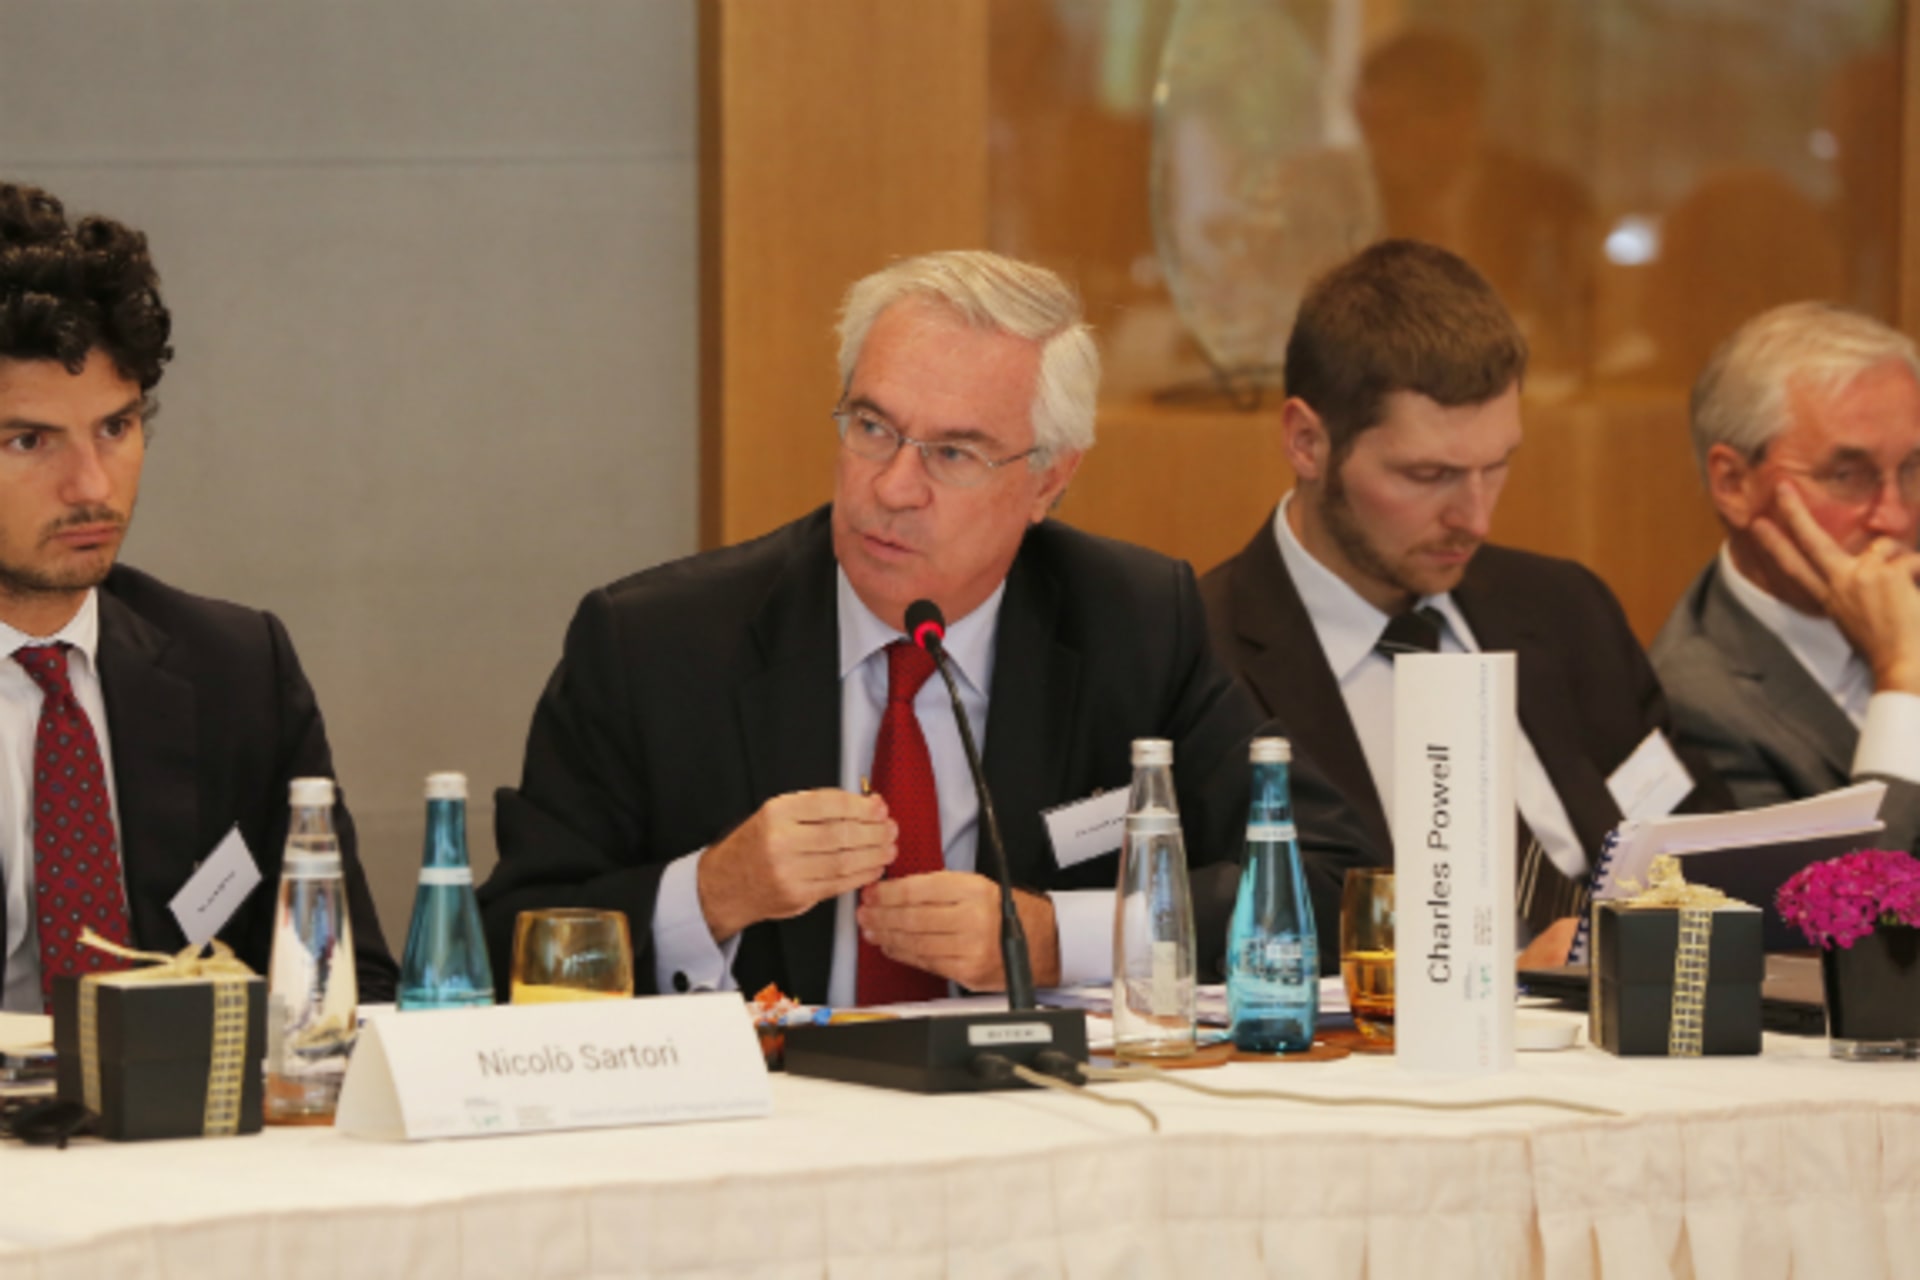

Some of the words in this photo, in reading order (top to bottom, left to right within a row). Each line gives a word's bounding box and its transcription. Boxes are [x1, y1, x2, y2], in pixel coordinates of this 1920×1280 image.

[1426, 743, 1451, 851] Powell
[1426, 861, 1451, 984] Charles
[477, 1046, 574, 1077] Nicolò
[579, 1038, 679, 1071] Sartori
